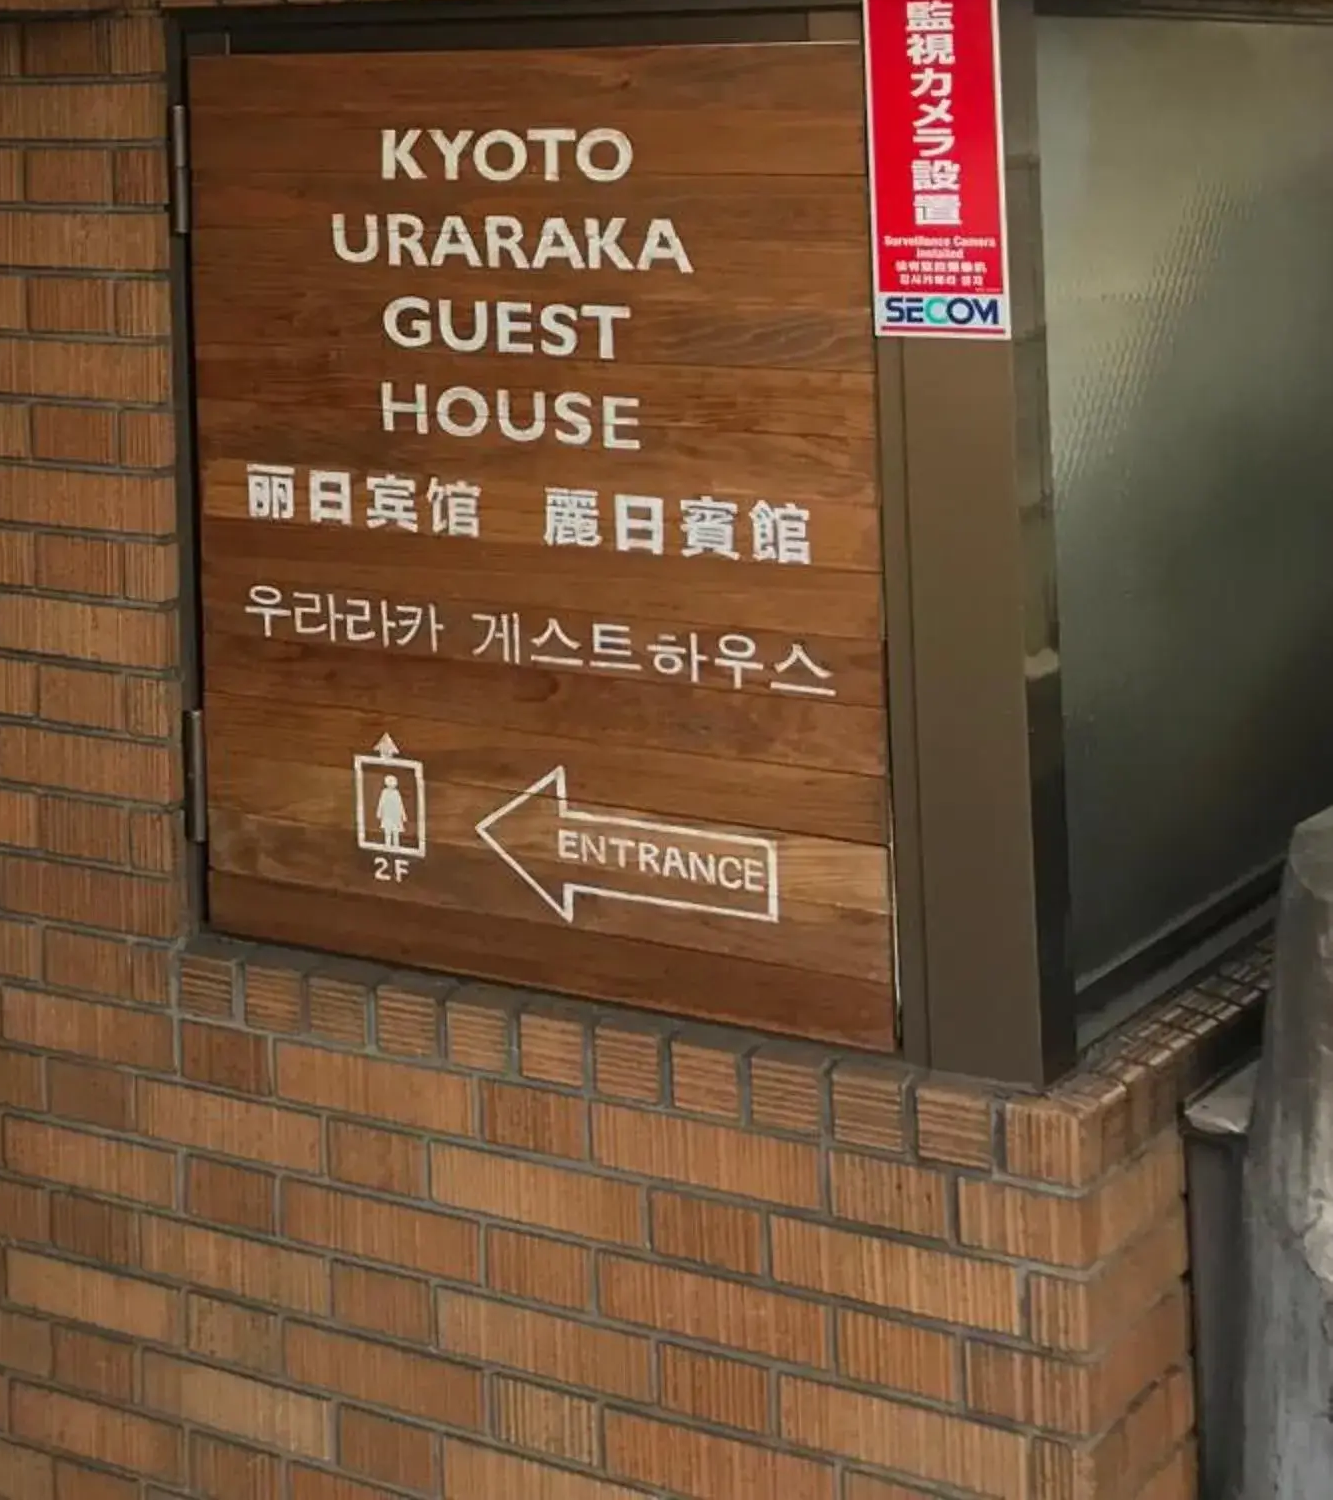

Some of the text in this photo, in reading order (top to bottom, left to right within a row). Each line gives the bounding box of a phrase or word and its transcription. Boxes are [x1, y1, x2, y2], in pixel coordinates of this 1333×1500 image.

[905, 0, 963, 227] 監視カメラ設置
[381, 128, 633, 182] KYOTO
[331, 213, 694, 274] URARAKA
[382, 296, 631, 360] GUEST
[885, 296, 1000, 326] SECOM
[381, 381, 641, 450] HOUSE
[246, 463, 812, 566] 丽日宾馆 麗日賓館
[245, 584, 837, 697] 우라라카 게스트하우스
[373, 856, 410, 883] 2F
[558, 829, 766, 893] ENTRANCE
